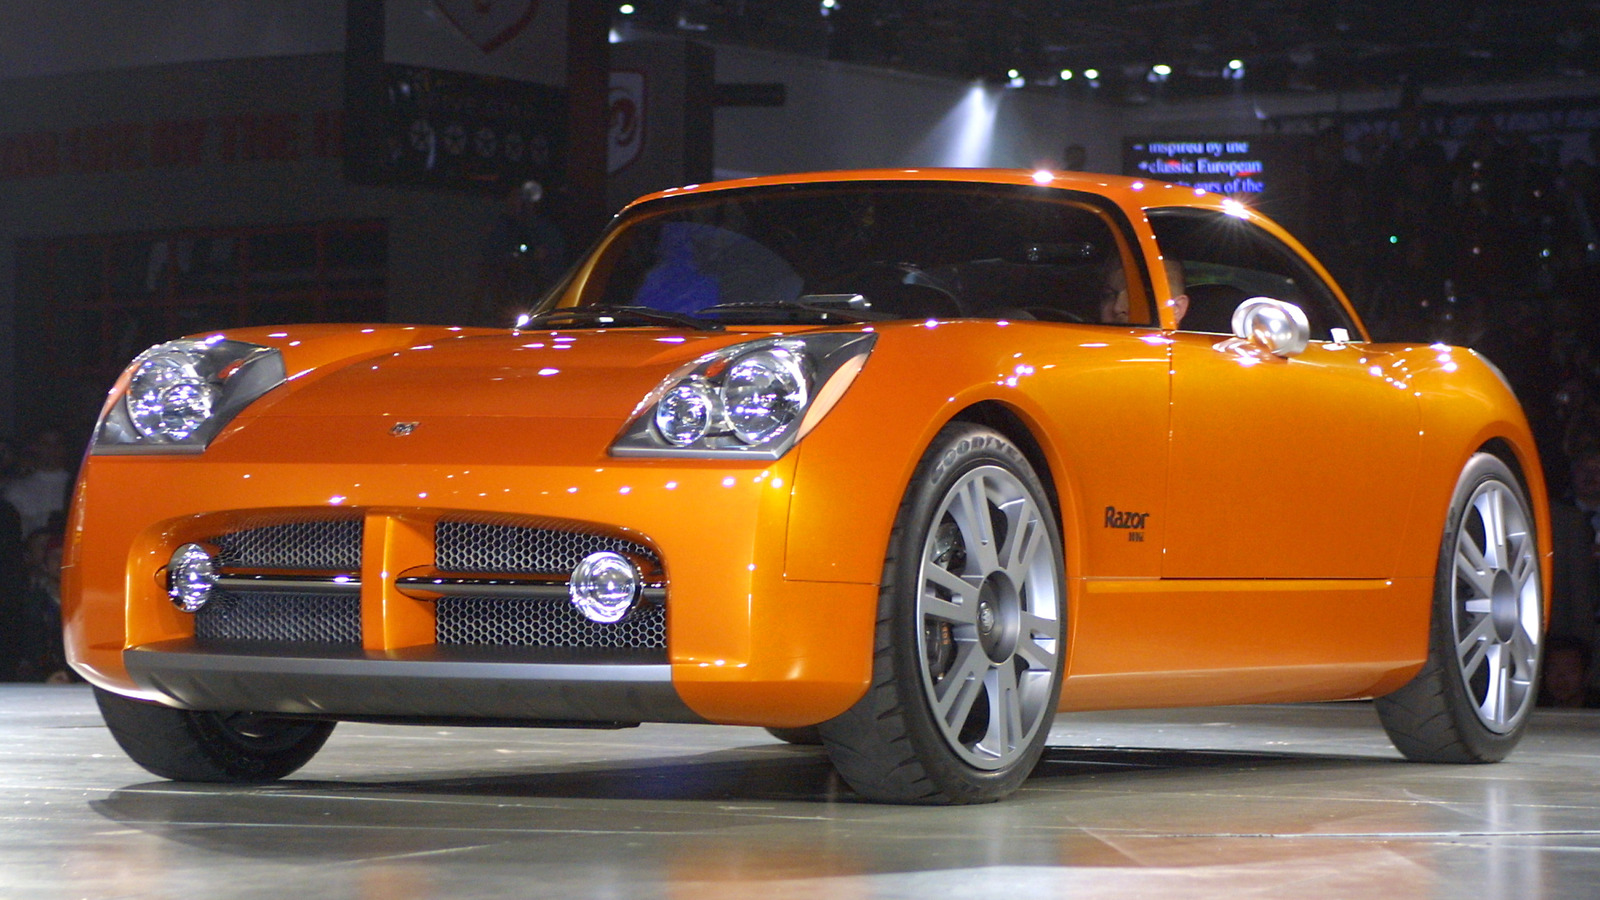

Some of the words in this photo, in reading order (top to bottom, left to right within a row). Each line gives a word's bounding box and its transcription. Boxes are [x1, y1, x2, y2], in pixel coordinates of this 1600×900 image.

[1148, 158, 1195, 173] classic
[1197, 158, 1263, 176] European
[1223, 178, 1241, 193] of
[1242, 177, 1264, 193] the
[1104, 506, 1150, 529] Razor
